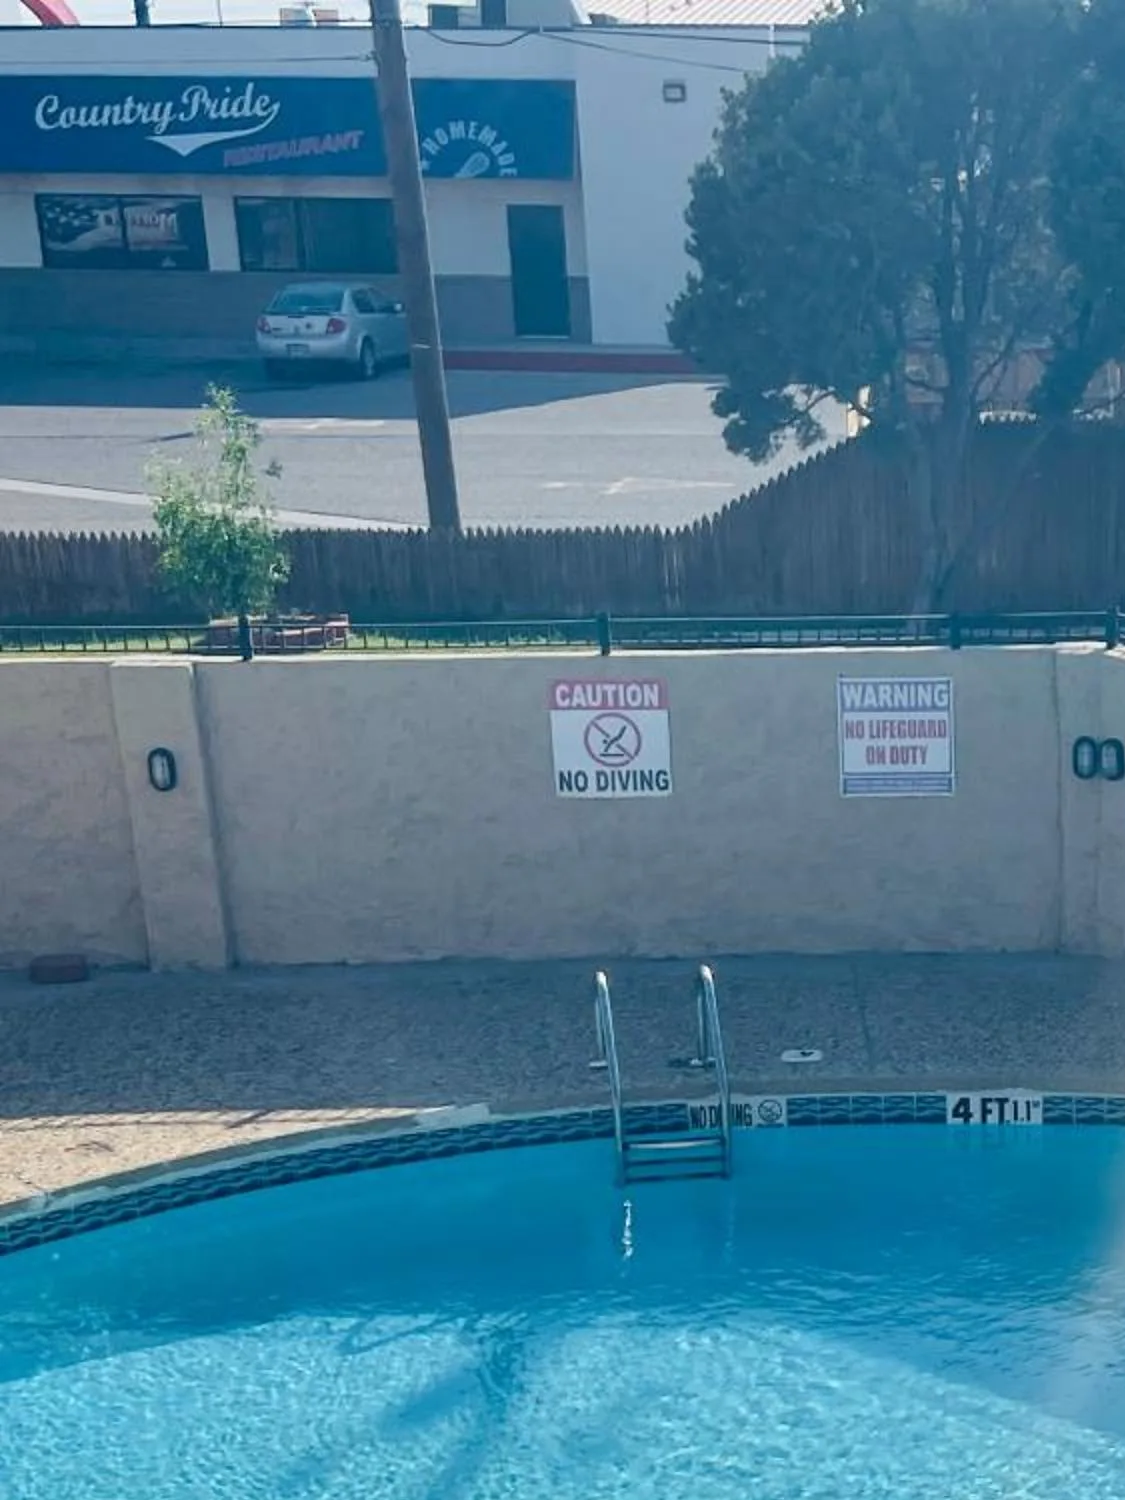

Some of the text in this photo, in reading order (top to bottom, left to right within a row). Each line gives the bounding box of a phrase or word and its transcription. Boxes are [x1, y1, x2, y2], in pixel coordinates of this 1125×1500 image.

[35, 82, 276, 134] Country Pride
[422, 119, 518, 177] HOMEMADE
[554, 683, 660, 708] CAUTION
[842, 683, 949, 708] WARNING
[844, 717, 948, 740] NO LIFEGUARD
[865, 745, 929, 766] ON DUTY
[558, 769, 670, 794] NO DIVING
[690, 1104, 707, 1129] NO
[952, 1097, 974, 1125] 4
